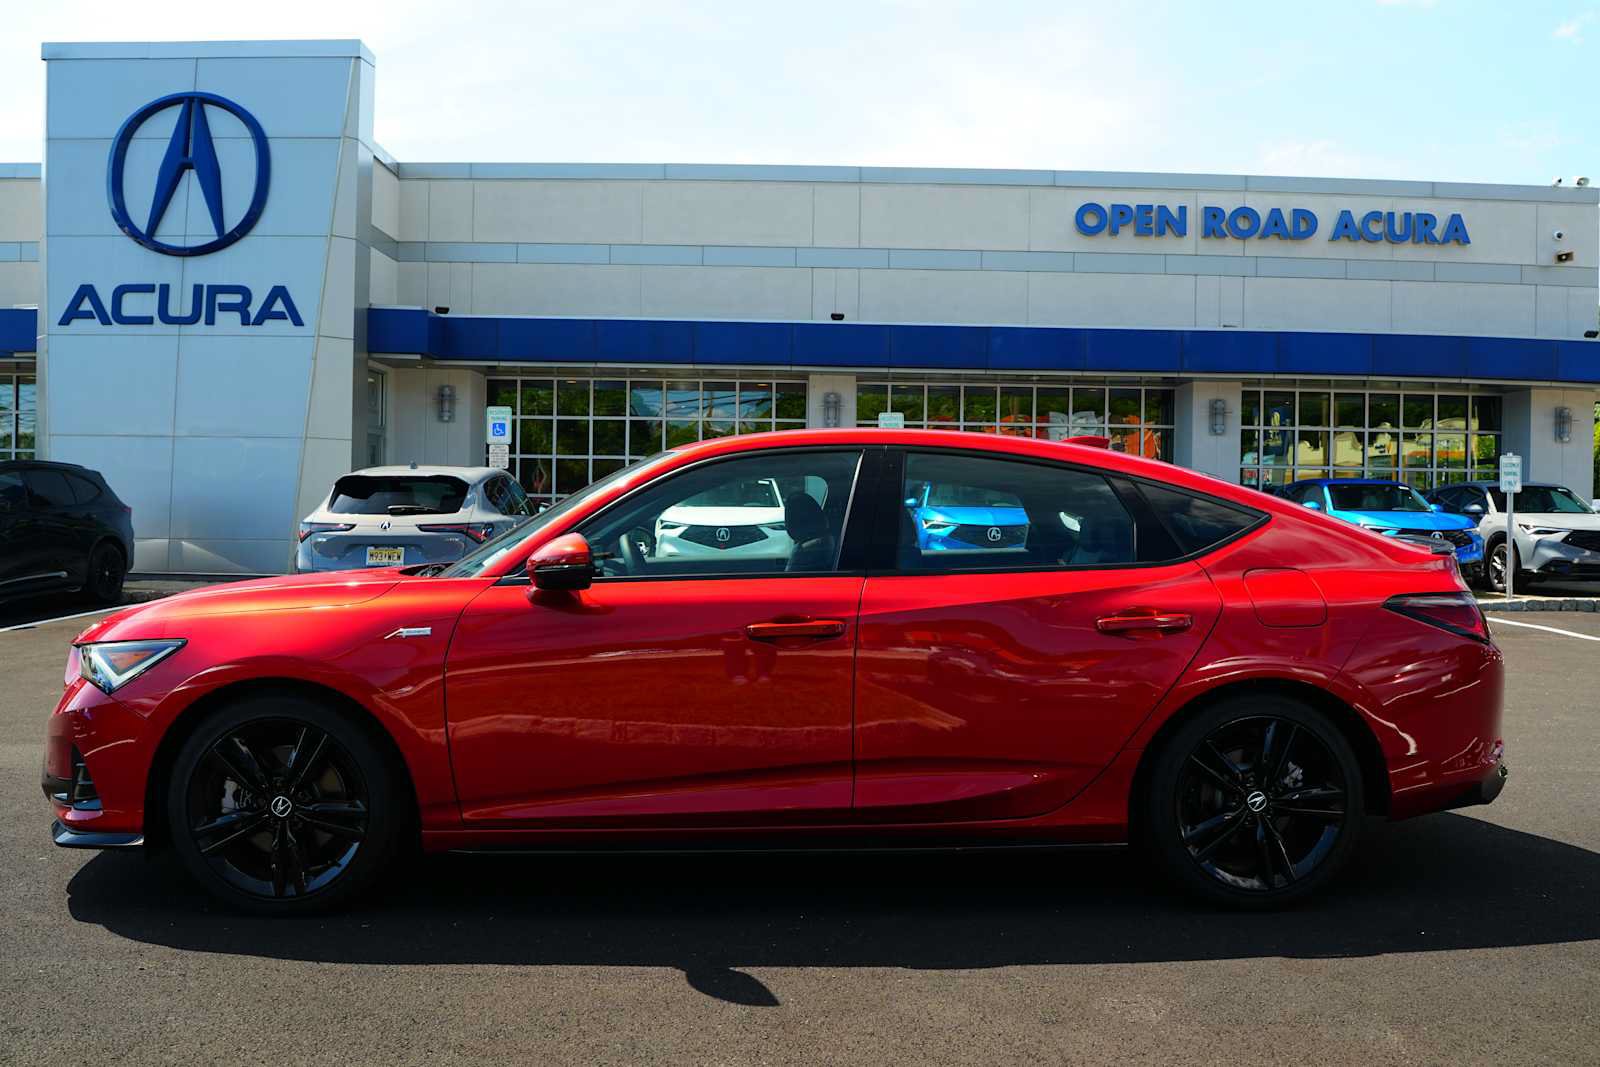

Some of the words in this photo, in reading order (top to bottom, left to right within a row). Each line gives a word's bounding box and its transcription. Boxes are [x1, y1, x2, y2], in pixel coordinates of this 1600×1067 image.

[1075, 202, 1188, 237] OPEN
[1202, 206, 1319, 241] ROAD
[1330, 209, 1471, 245] ACURA
[57, 283, 305, 326] ACURA
